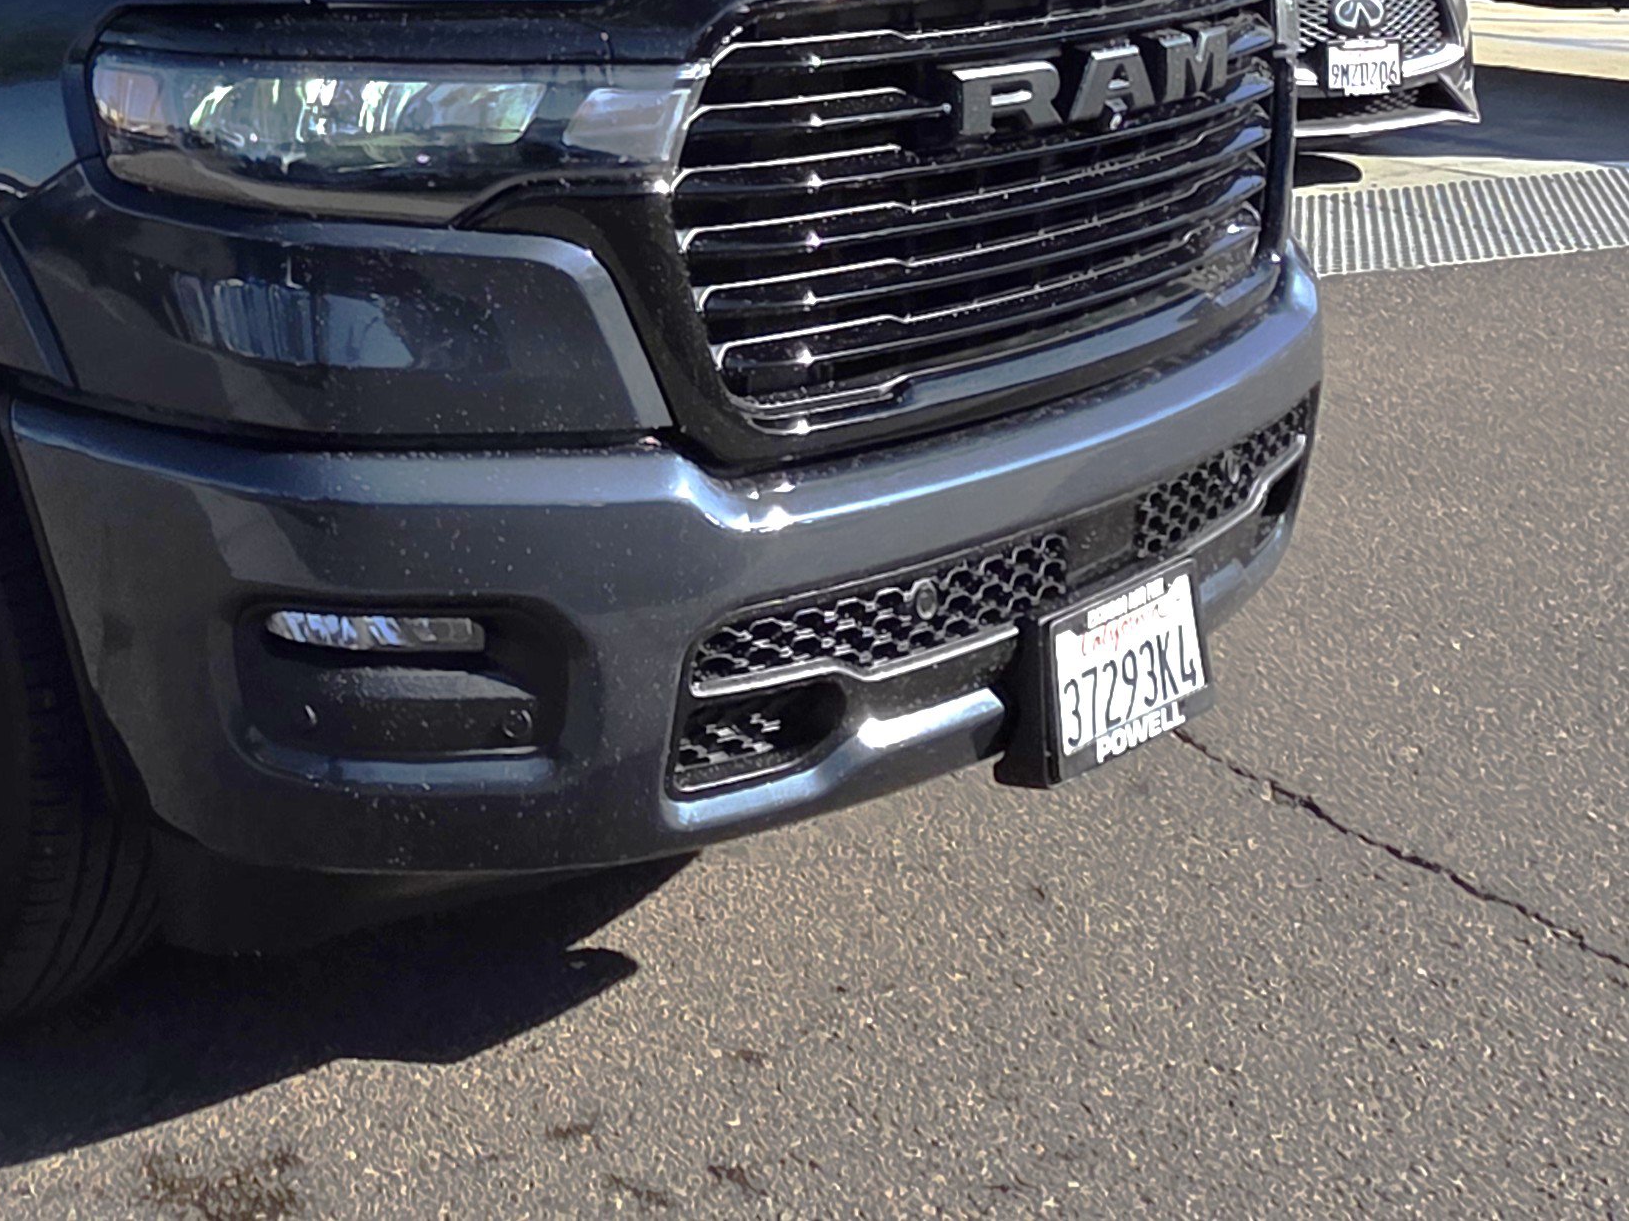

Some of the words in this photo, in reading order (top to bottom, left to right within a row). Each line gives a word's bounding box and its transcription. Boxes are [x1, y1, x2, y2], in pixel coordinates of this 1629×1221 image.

[952, 25, 1229, 135] RAM
[1063, 624, 1197, 748] 37293K4
[1095, 700, 1186, 764] POWELL
